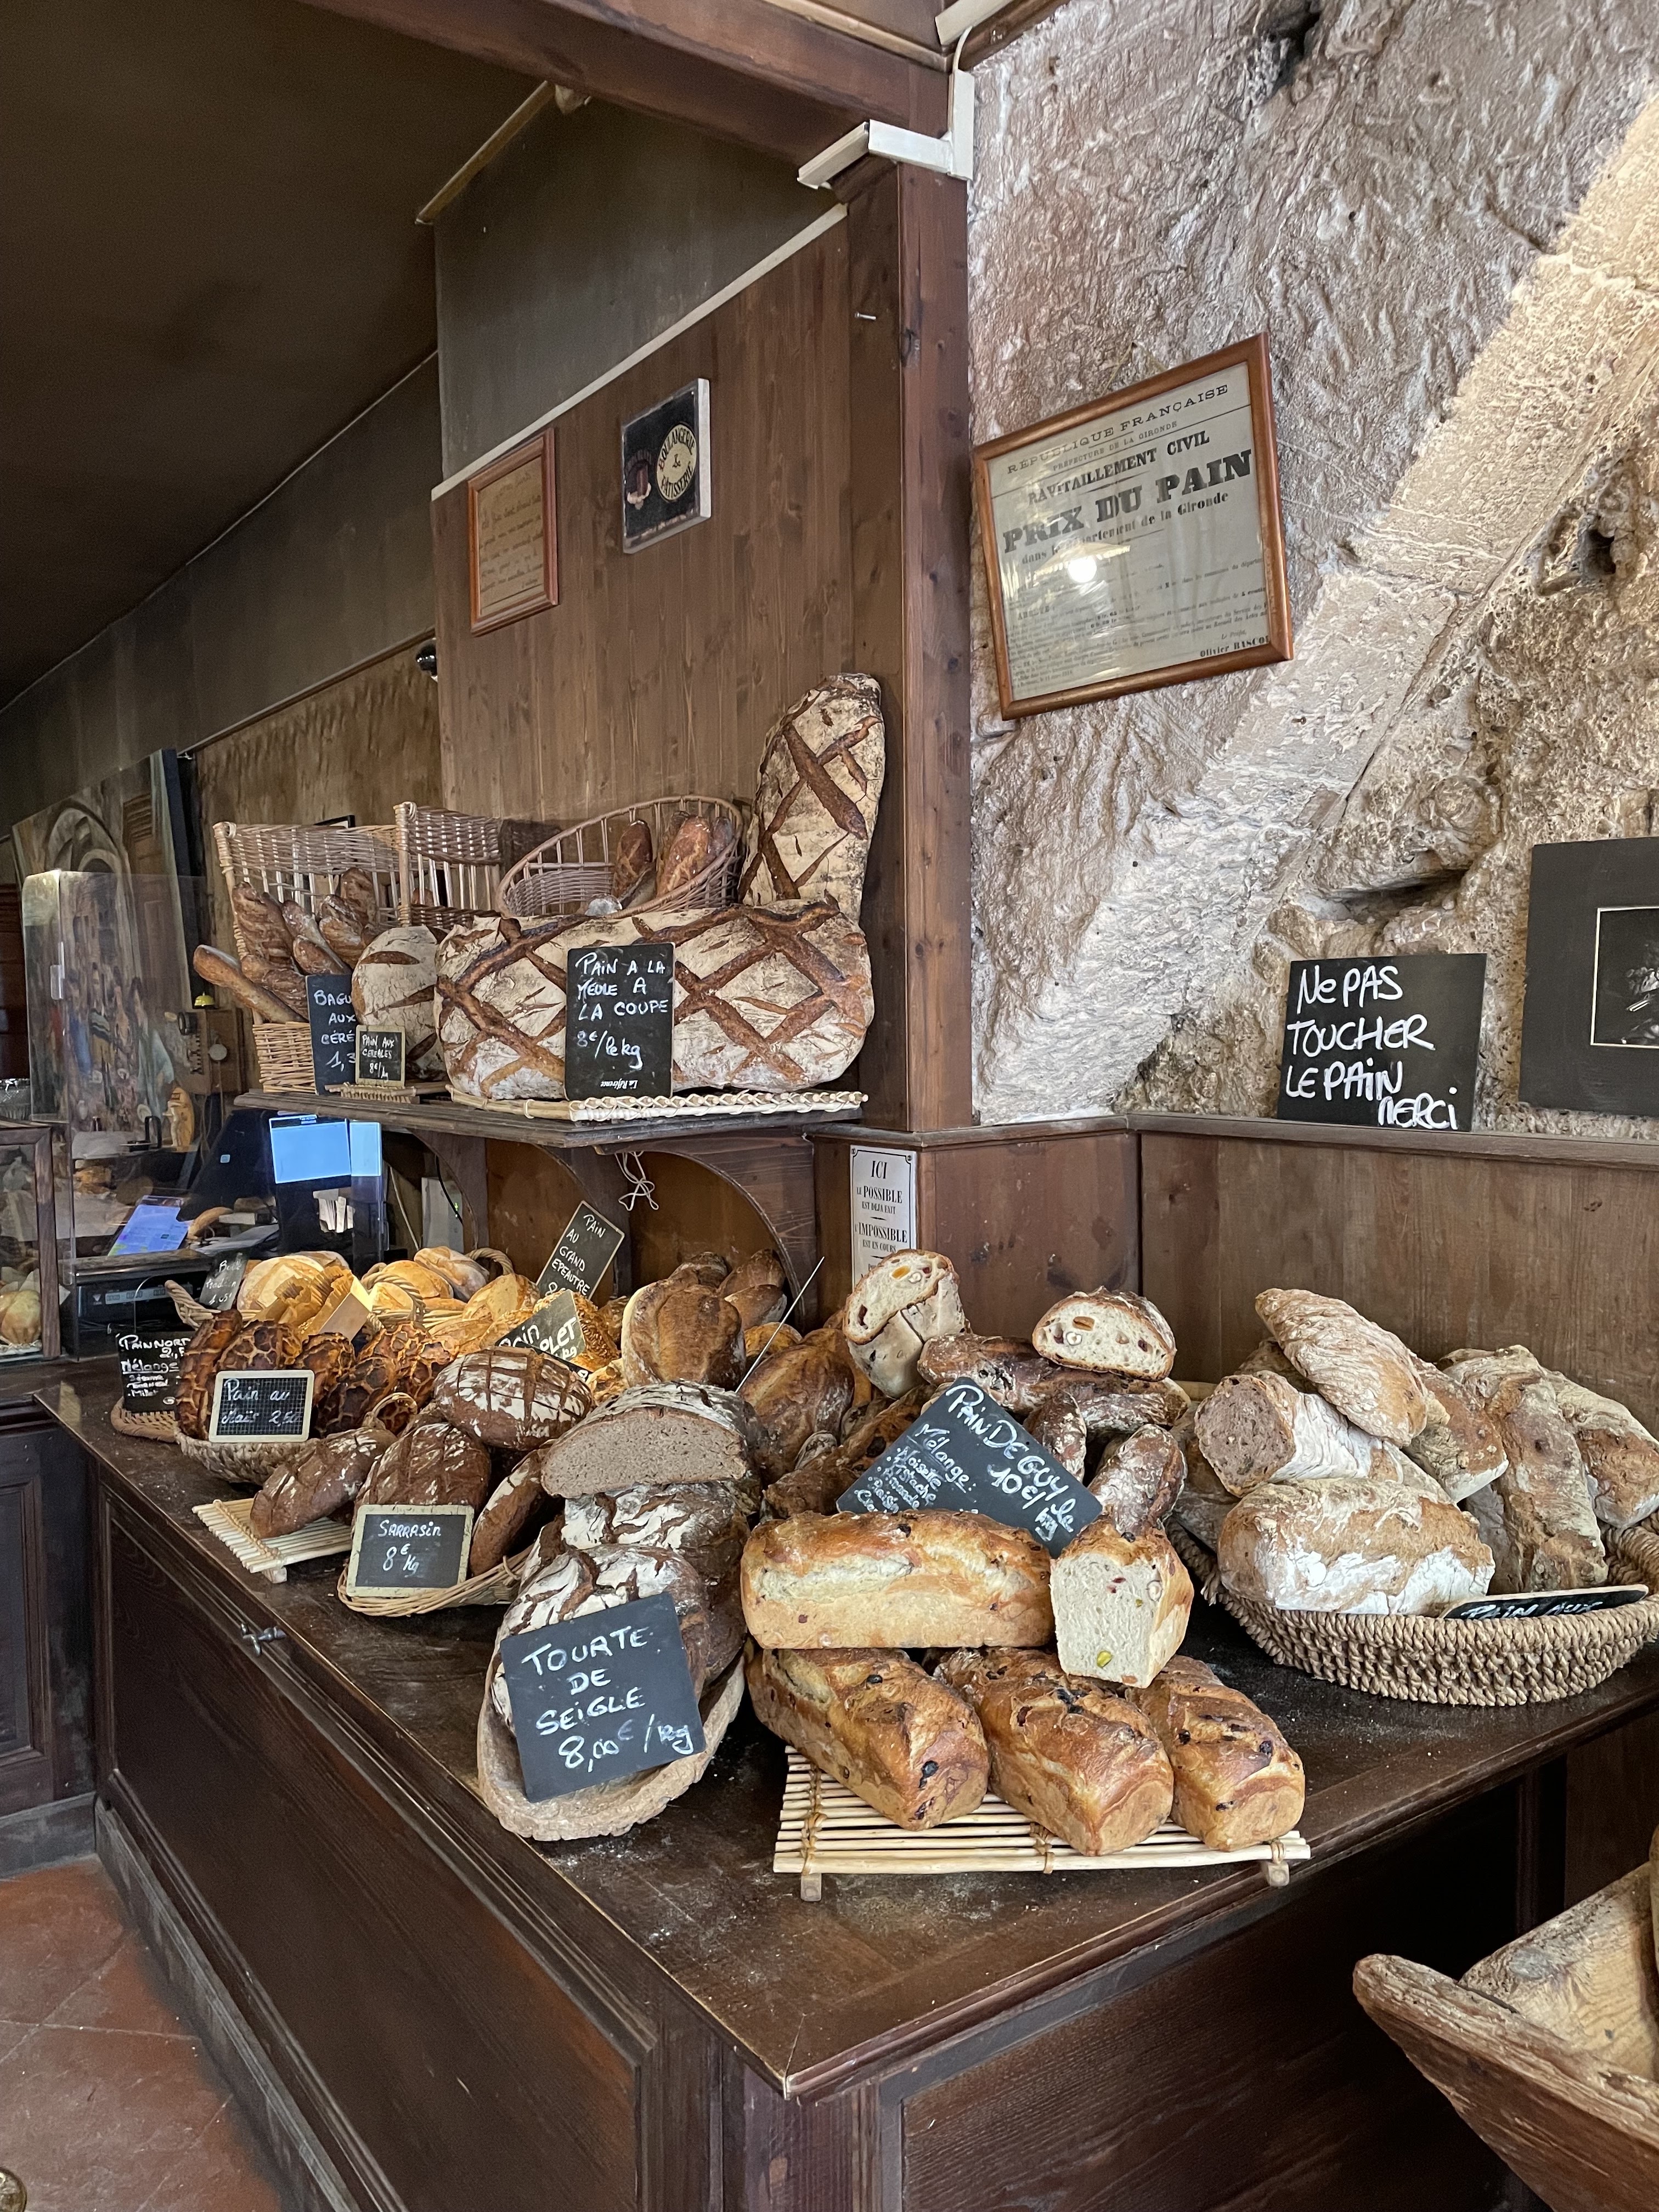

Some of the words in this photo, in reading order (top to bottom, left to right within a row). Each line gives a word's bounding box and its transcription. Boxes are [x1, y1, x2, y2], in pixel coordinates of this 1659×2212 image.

[1120, 384, 1228, 431] FRANÇAISE
[1138, 420, 1177, 439] GIRONDE
[659, 427, 695, 472] BOULANGERIE
[1028, 447, 1157, 505] RAVITAILLEMENT
[1167, 430, 1210, 455] CIVIL
[1002, 505, 1085, 554] PRIX
[1095, 485, 1142, 522] DU
[1155, 448, 1251, 504] PAIN
[1177, 492, 1228, 515] Gironde
[627, 960, 638, 976] A
[647, 960, 665, 974] LA
[632, 976, 647, 995] A
[1296, 964, 1337, 1014] Ne
[1342, 965, 1403, 1008] PAS
[328, 1012, 357, 1026] AUX
[578, 1003, 603, 1022] LA
[613, 999, 669, 1016] COUPE
[1286, 1013, 1436, 1058] TOUCHER
[1285, 1065, 1318, 1098] LE
[870, 1160, 887, 1180] ICI
[863, 1184, 902, 1204] POSSIBLE
[861, 1201, 870, 1210] EST
[884, 1205, 896, 1215] FAIT
[566, 1228, 580, 1244] AU
[862, 1239, 871, 1248] EST
[551, 1258, 590, 1296] EPEAUTRE
[223, 1378, 259, 1401] Pain
[269, 1390, 290, 1401] au
[983, 1419, 1030, 1460] DE
[521, 1625, 650, 1675] TOURTE
[567, 1668, 612, 1695] DE
